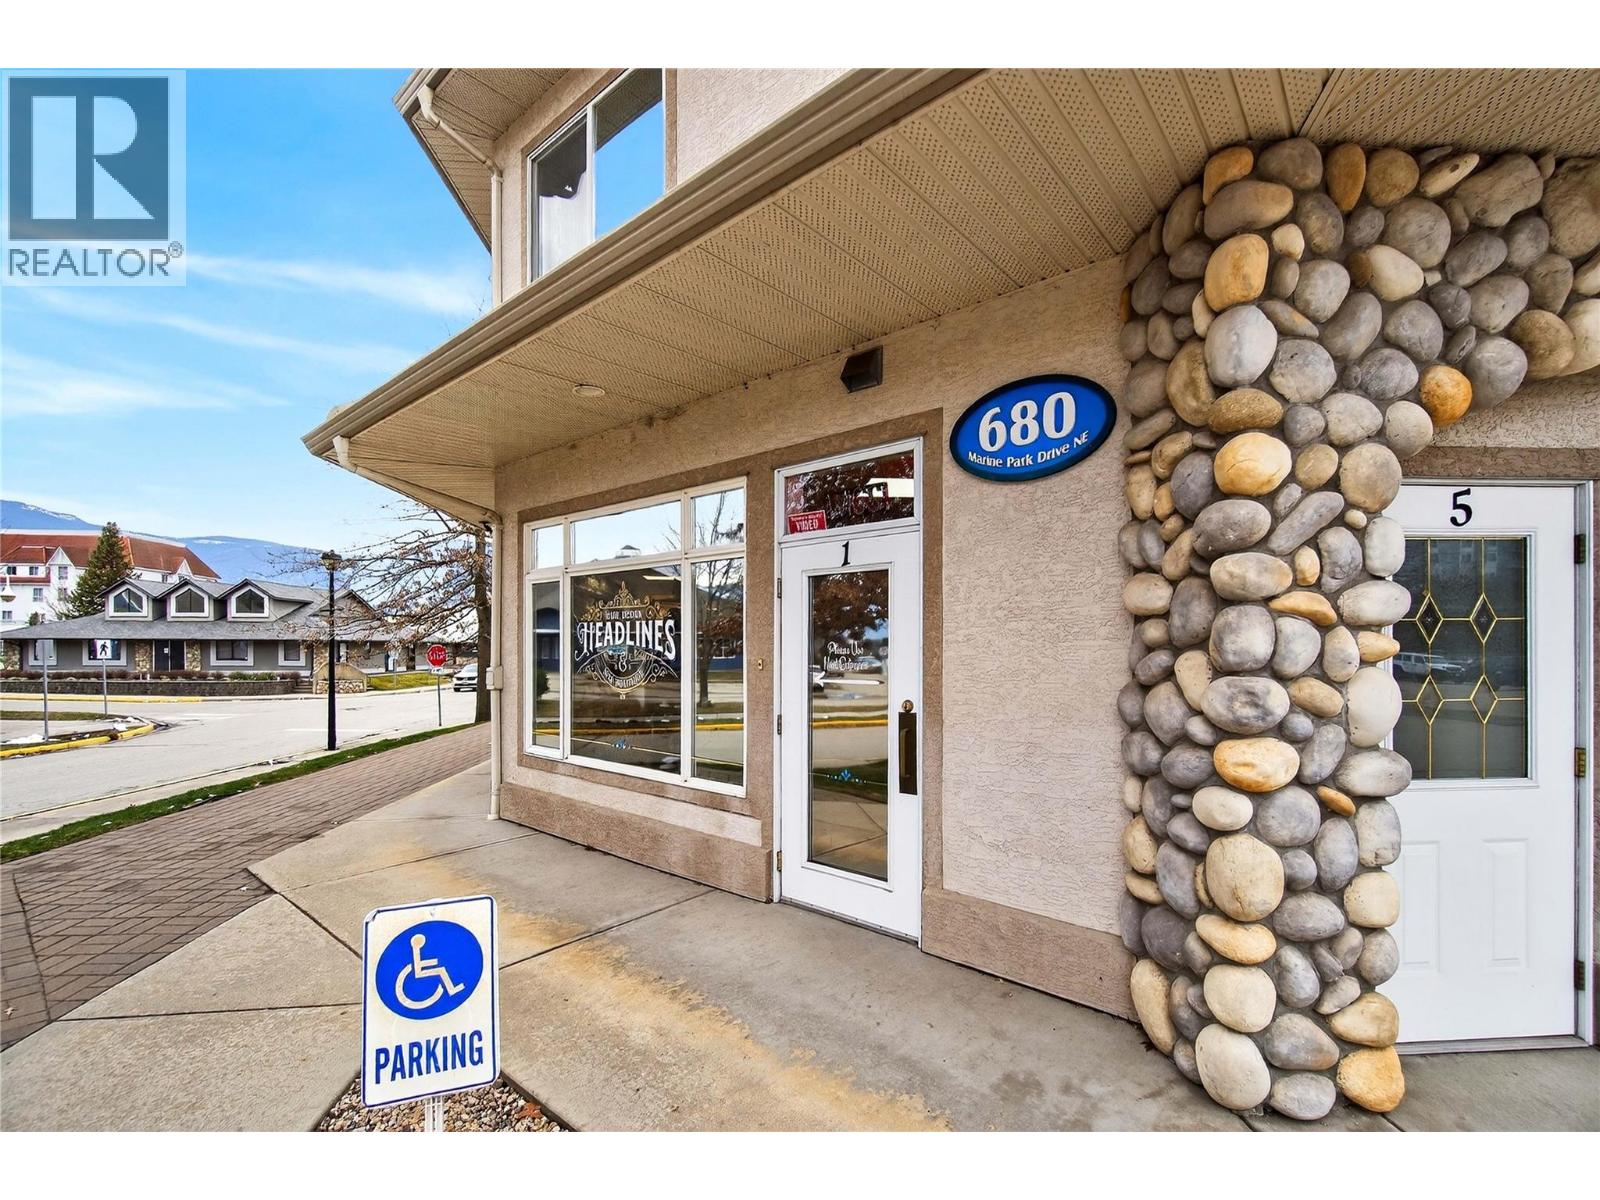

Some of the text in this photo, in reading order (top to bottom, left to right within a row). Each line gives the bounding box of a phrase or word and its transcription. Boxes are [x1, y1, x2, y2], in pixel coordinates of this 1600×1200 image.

[978, 391, 1077, 453] 680
[968, 430, 1090, 468] Marine Park Drive NE
[1449, 487, 1473, 527] 5
[841, 540, 851, 568] 1
[575, 618, 677, 661] HEADLINES
[374, 1029, 484, 1085] PARKING
